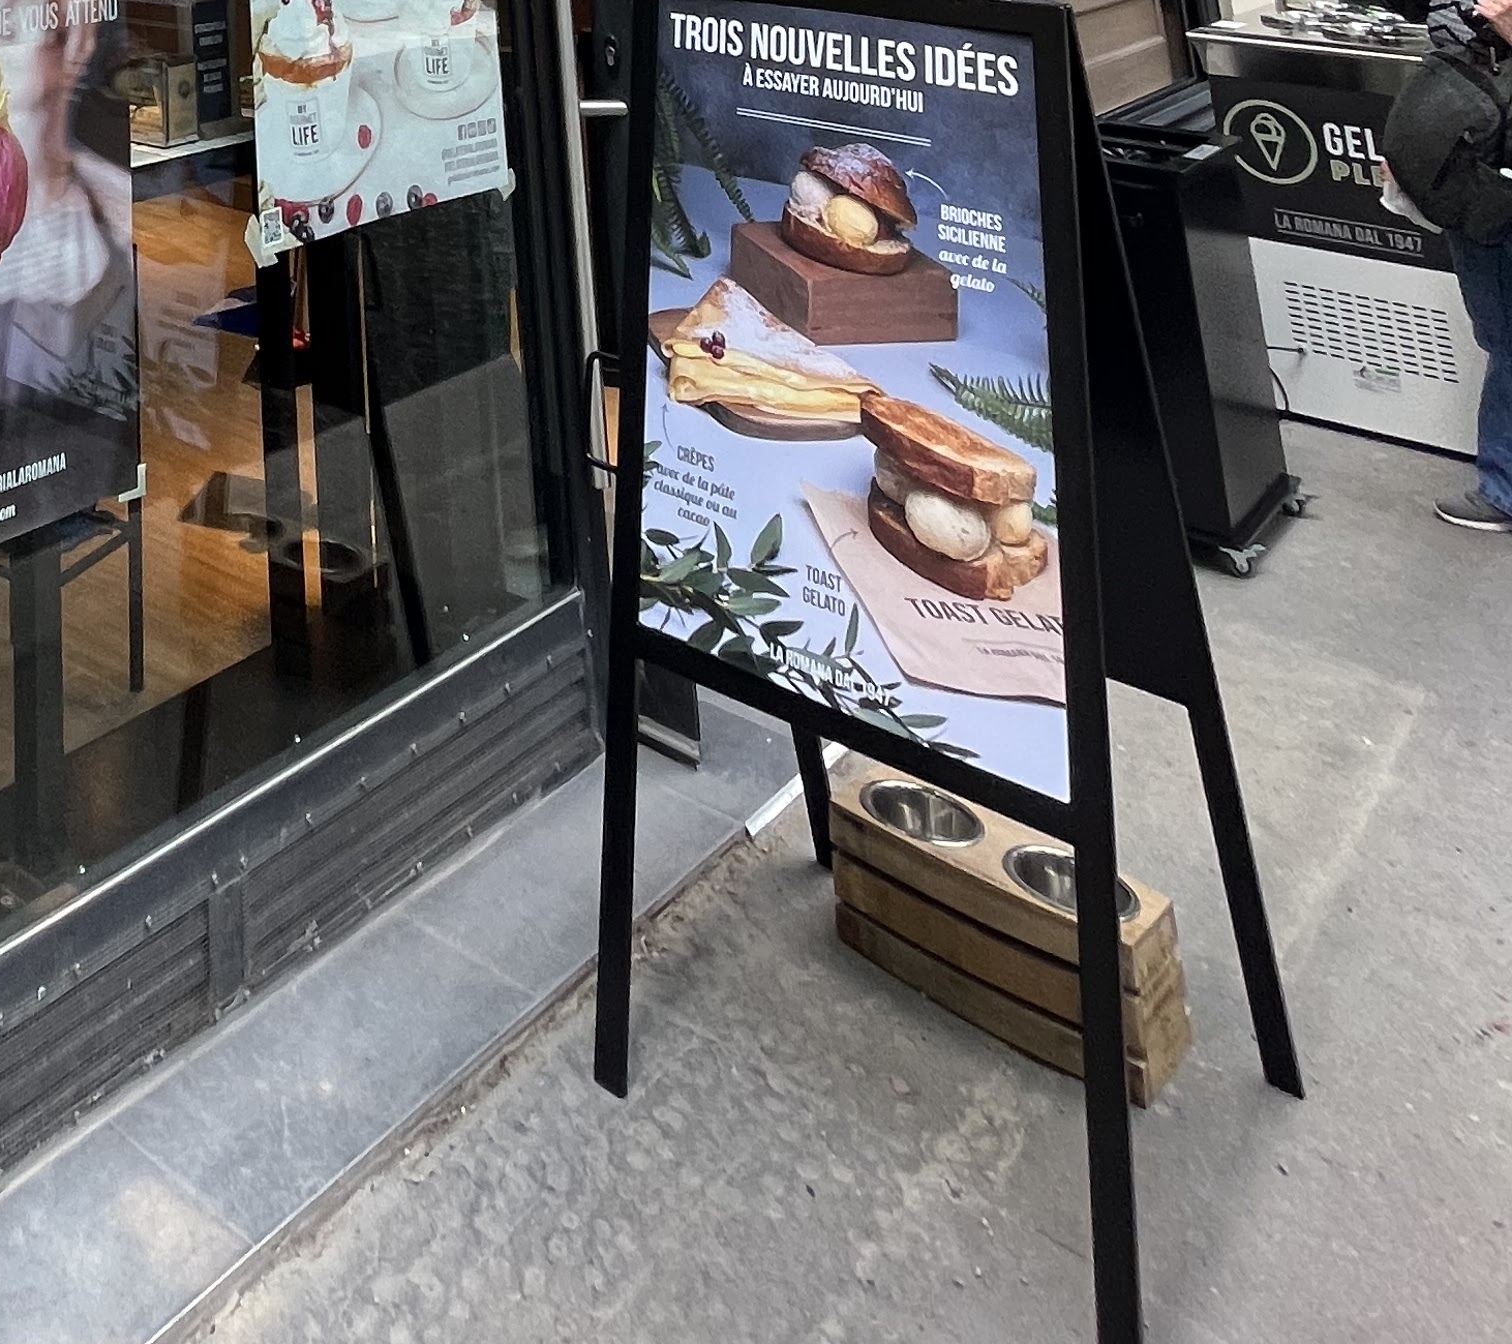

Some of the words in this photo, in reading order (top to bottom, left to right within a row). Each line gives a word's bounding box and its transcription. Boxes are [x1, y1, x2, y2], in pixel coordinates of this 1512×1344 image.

[19, 3, 61, 35] VOUS
[425, 56, 450, 76] LIFE
[669, 11, 745, 58] TROIS
[750, 22, 918, 84] NOUVELLES
[923, 42, 1021, 98] IDÉES
[742, 61, 755, 88] À
[754, 70, 820, 98] ESSAYER
[822, 81, 925, 113] AUJOURD'HUI
[291, 123, 320, 146] LIFE
[1321, 121, 1386, 163] GEL
[1329, 158, 1385, 189] PLE
[939, 203, 1004, 233] BRIOCHES
[1273, 211, 1294, 231] LA
[1294, 216, 1354, 241] ROMANA
[1354, 225, 1384, 247] DAL
[1387, 232, 1424, 253] 1947
[937, 223, 1008, 255] SICILIENNE
[938, 248, 971, 269] avec
[971, 252, 990, 271] de
[990, 256, 1009, 276] la
[949, 271, 997, 294] gelato
[676, 444, 716, 473] CRÊPES
[681, 471, 696, 487] de
[697, 476, 710, 492] la
[653, 478, 705, 509] classique
[705, 499, 720, 512] ou
[721, 504, 738, 521] au
[676, 505, 712, 528] cacao
[804, 563, 844, 594] TOAST
[801, 586, 847, 618] GELATO
[904, 596, 990, 626] TOAST
[769, 641, 786, 665] LA
[785, 648, 835, 686] ROMANA
